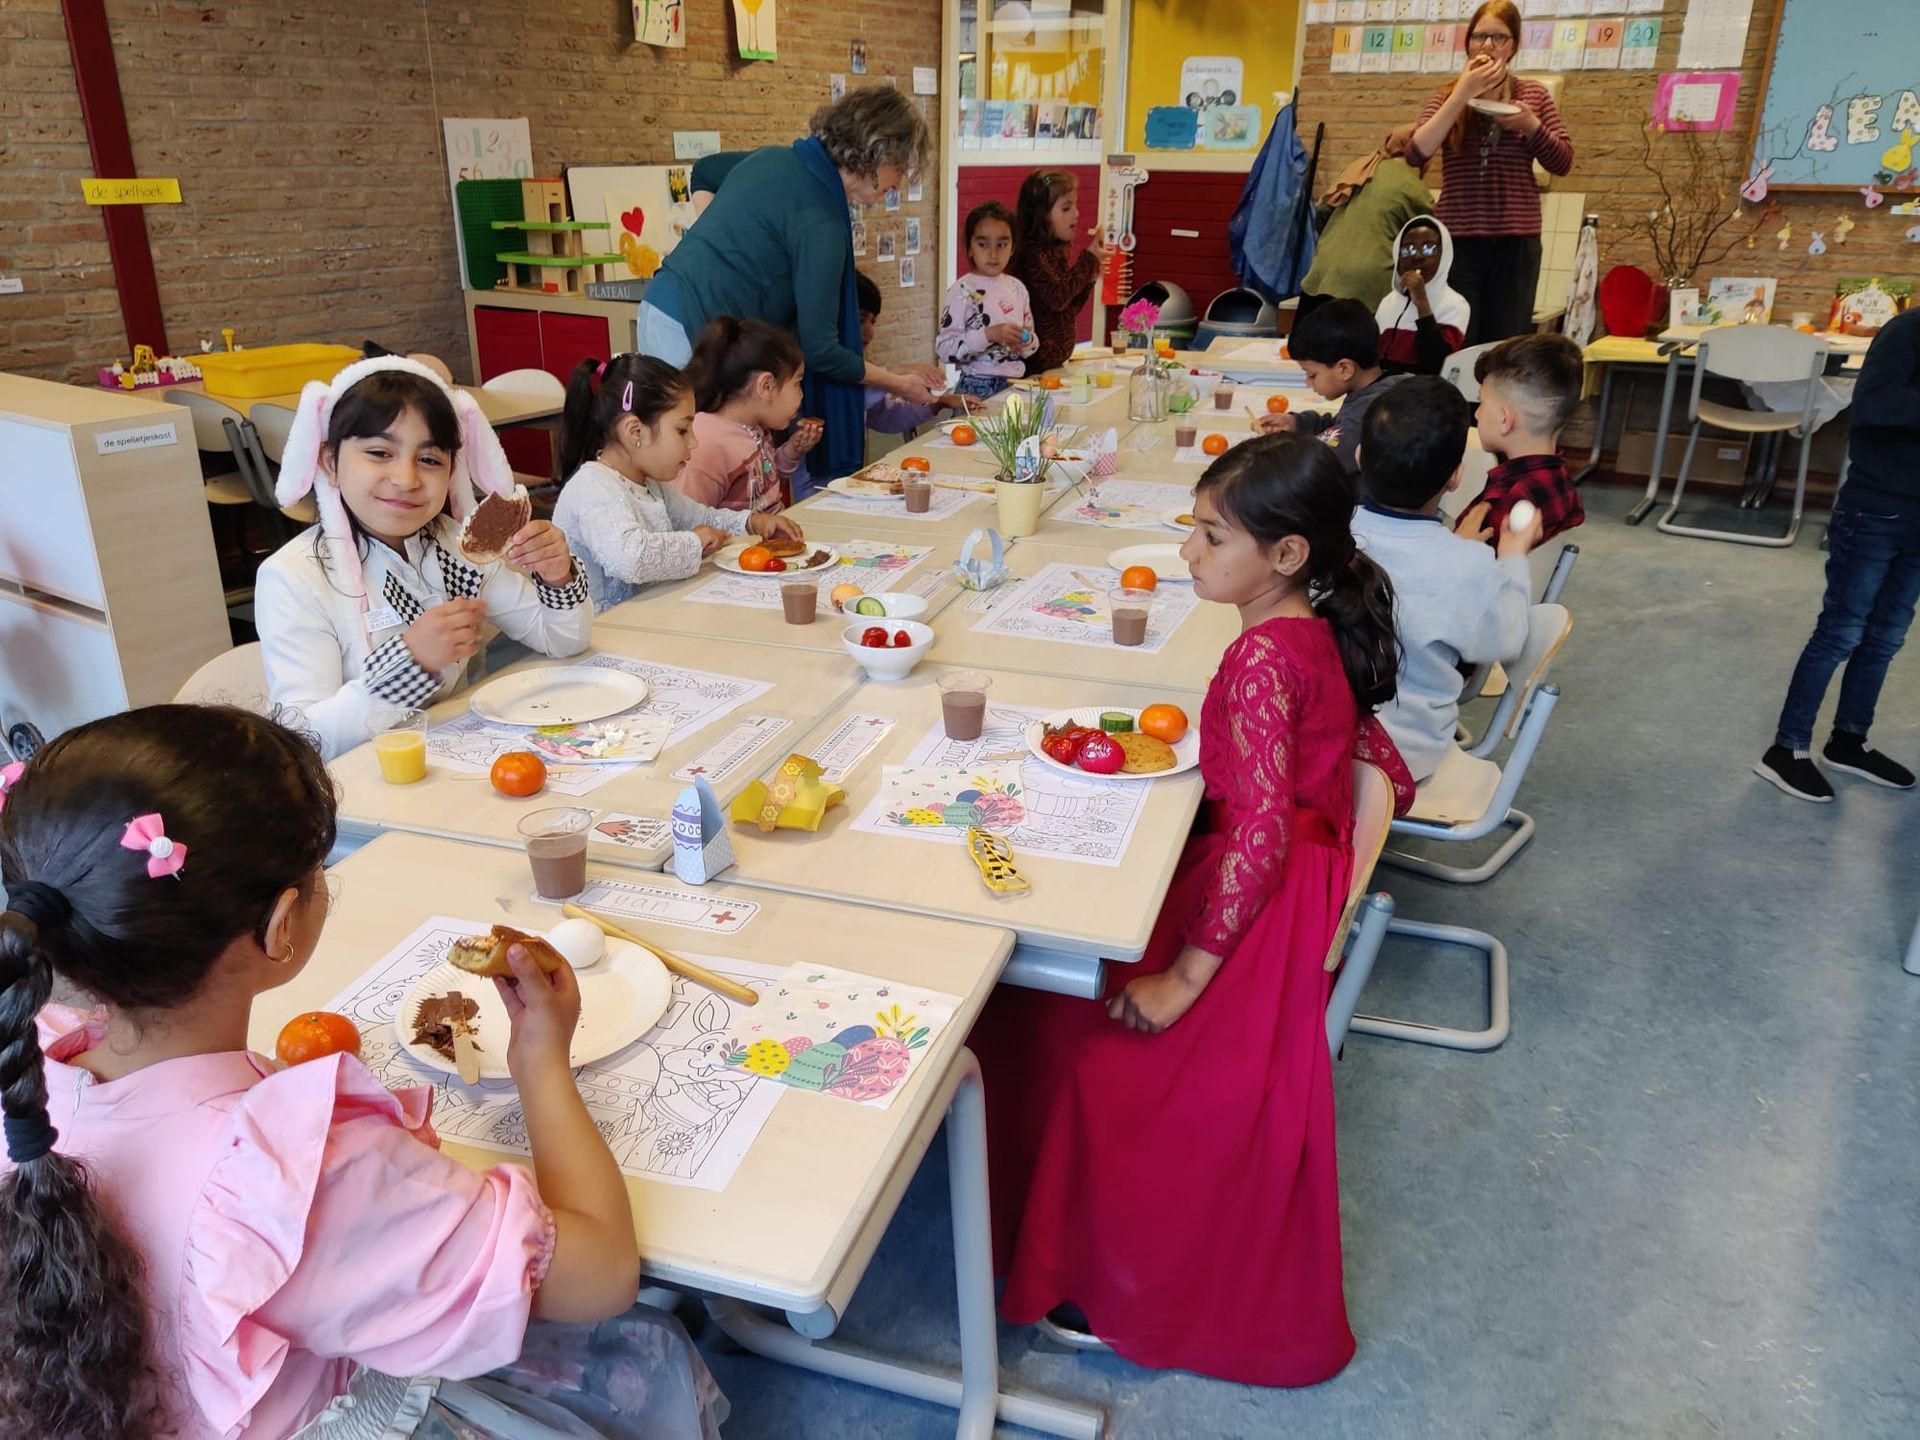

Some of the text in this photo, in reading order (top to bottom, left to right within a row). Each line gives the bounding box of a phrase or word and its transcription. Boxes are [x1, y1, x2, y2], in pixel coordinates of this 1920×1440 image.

[1370, 33, 1385, 47] 12
[1399, 34, 1414, 47] 13
[1431, 33, 1446, 47] 14
[1529, 30, 1544, 46] 17
[1561, 27, 1577, 42] 18
[1596, 27, 1614, 42] 19
[1631, 26, 1654, 42] 20
[91, 184, 108, 199] de
[588, 285, 631, 299] PLATEAU
[103, 431, 172, 448] de spelletjeskast
